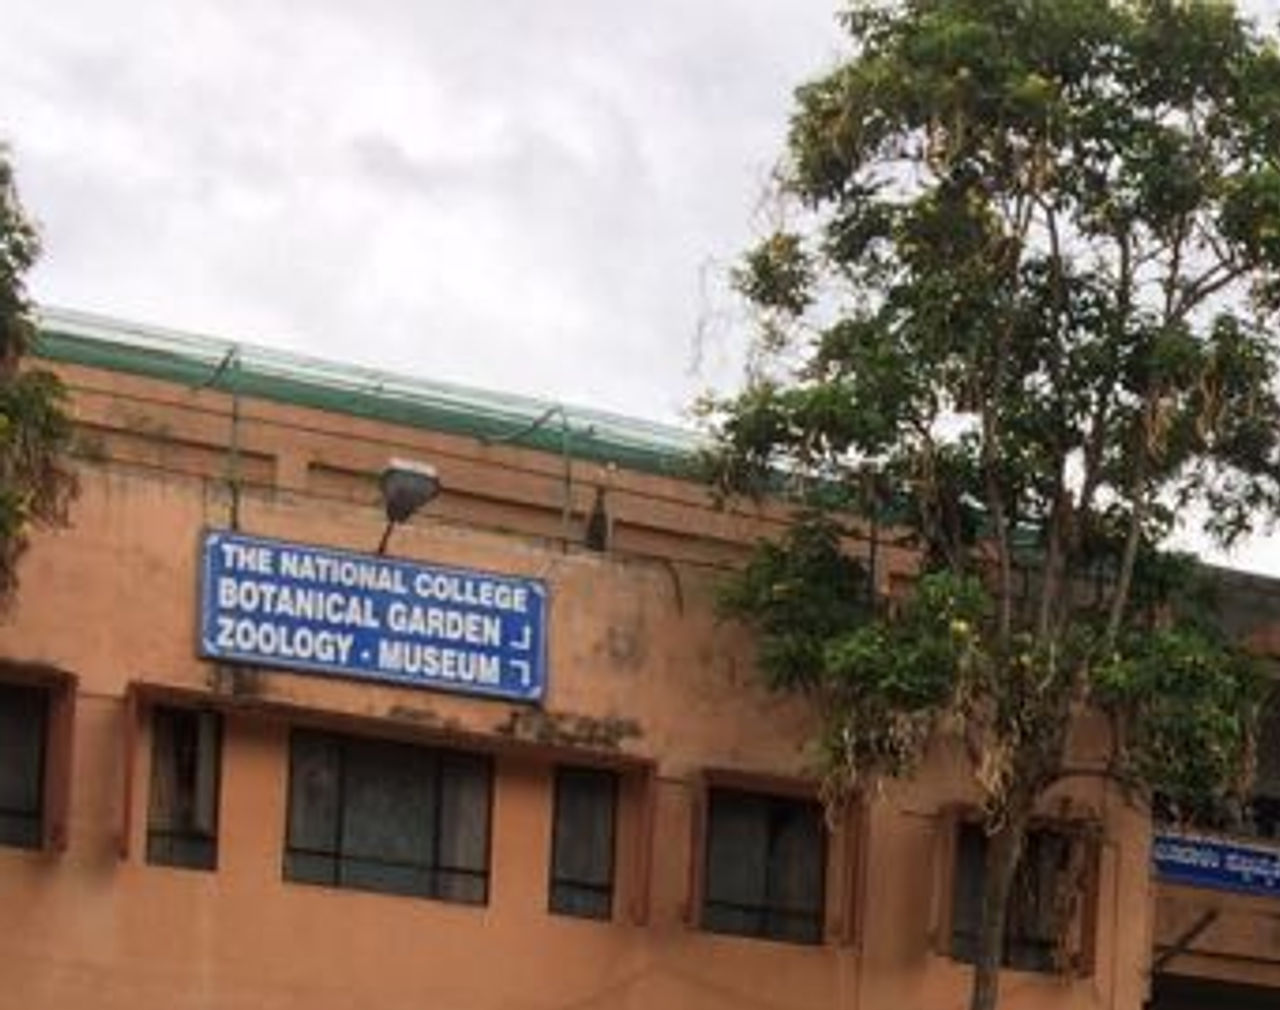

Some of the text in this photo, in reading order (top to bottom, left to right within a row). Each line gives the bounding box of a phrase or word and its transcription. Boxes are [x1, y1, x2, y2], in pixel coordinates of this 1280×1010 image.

[217, 577, 502, 647] BOTANICAL GARDEN
[221, 542, 528, 613] THE NATIONAL COLLEGE
[216, 617, 501, 685] ZOOLOGY MUSEUM
